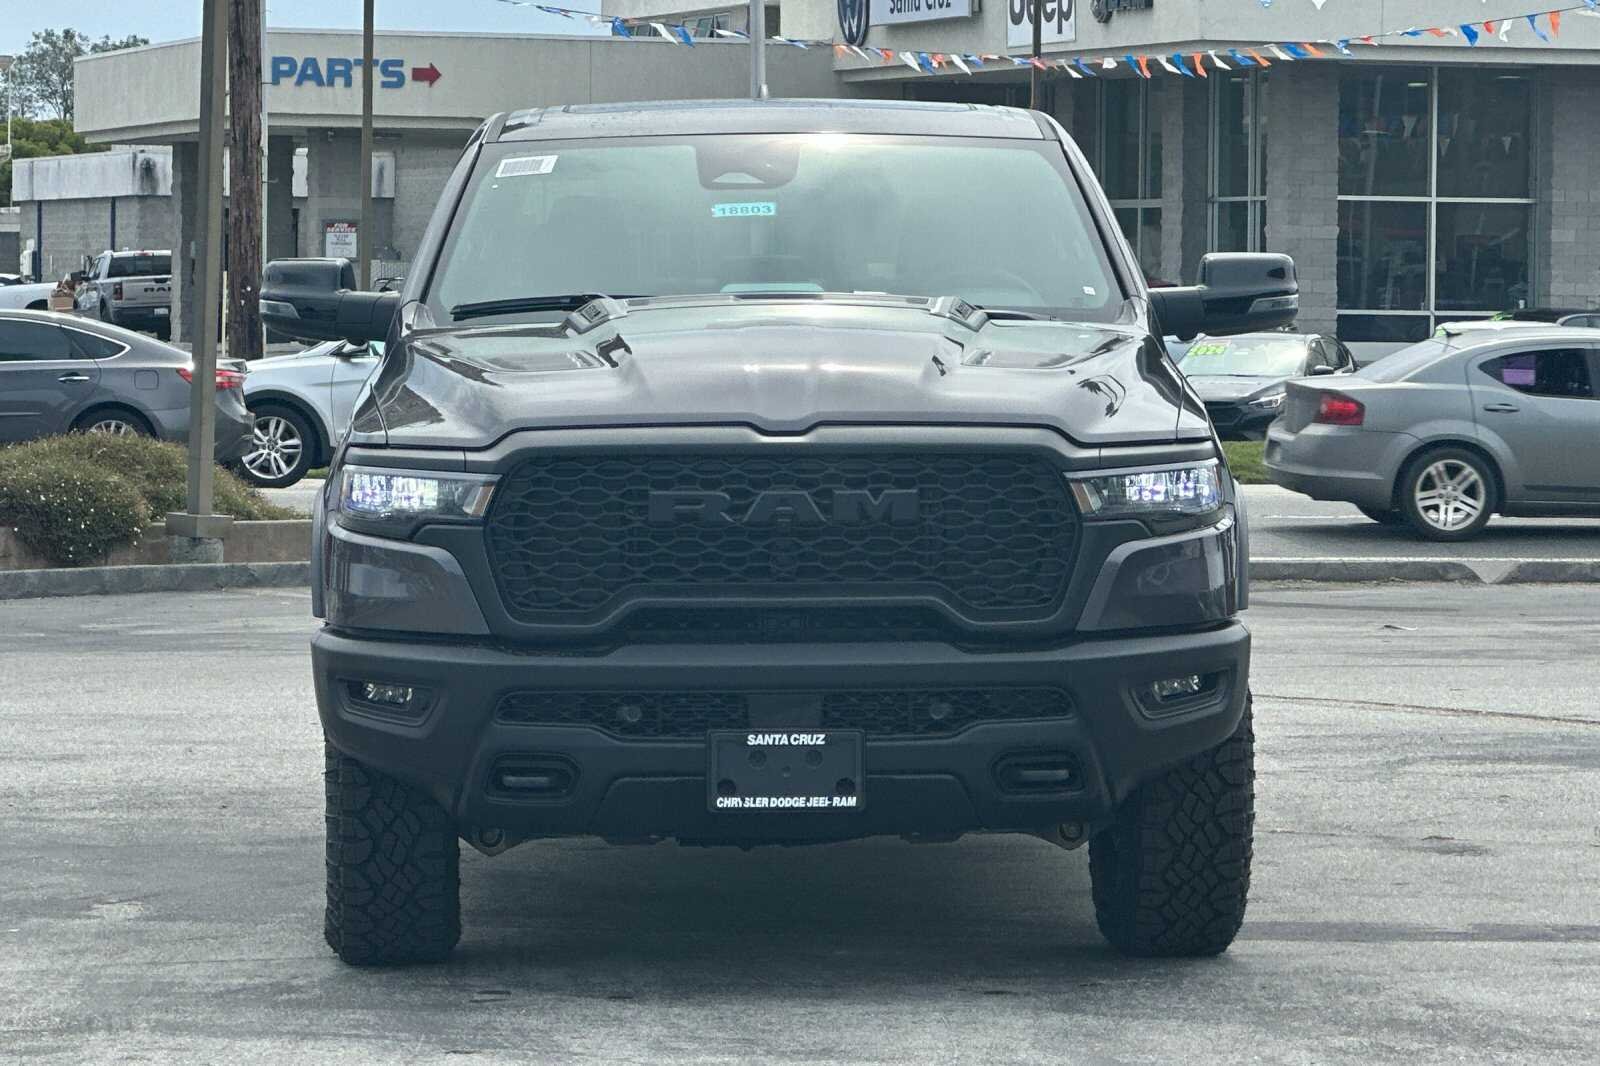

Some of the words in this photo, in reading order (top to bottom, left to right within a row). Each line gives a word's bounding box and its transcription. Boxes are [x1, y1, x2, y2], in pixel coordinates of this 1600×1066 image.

[648, 488, 920, 524] RAM
[746, 733, 789, 746] SANTA
[789, 733, 826, 745] CRUZ
[769, 796, 807, 807] DODGE
[832, 796, 857, 807] RAM
